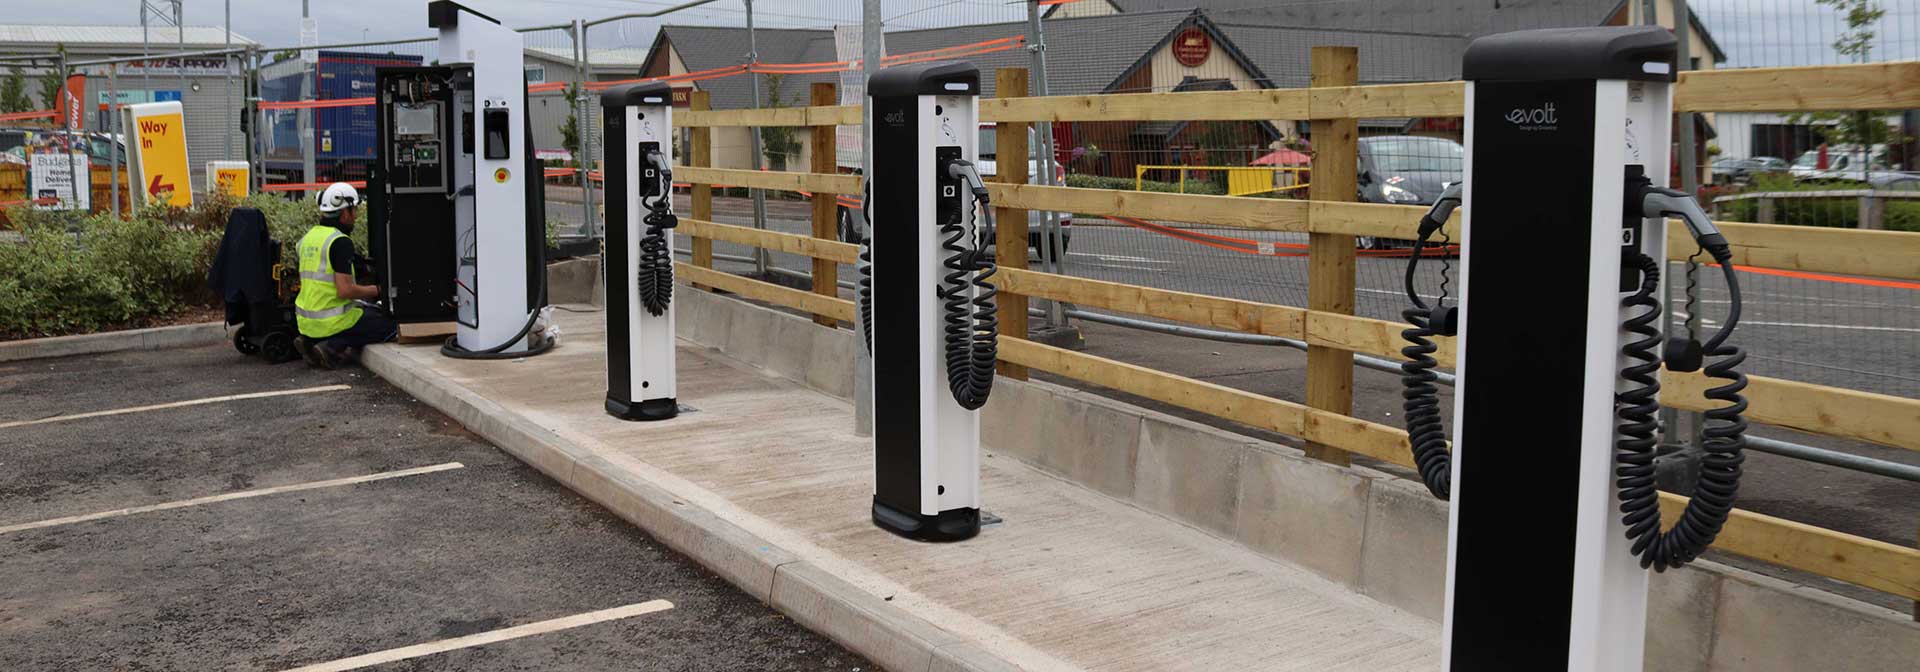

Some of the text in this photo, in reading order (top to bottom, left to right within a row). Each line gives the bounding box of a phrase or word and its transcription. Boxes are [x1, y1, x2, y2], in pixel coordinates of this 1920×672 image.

[1505, 102, 1557, 124] evolt
[141, 121, 167, 136] Way
[142, 137, 152, 148] In
[218, 172, 236, 181] Way
